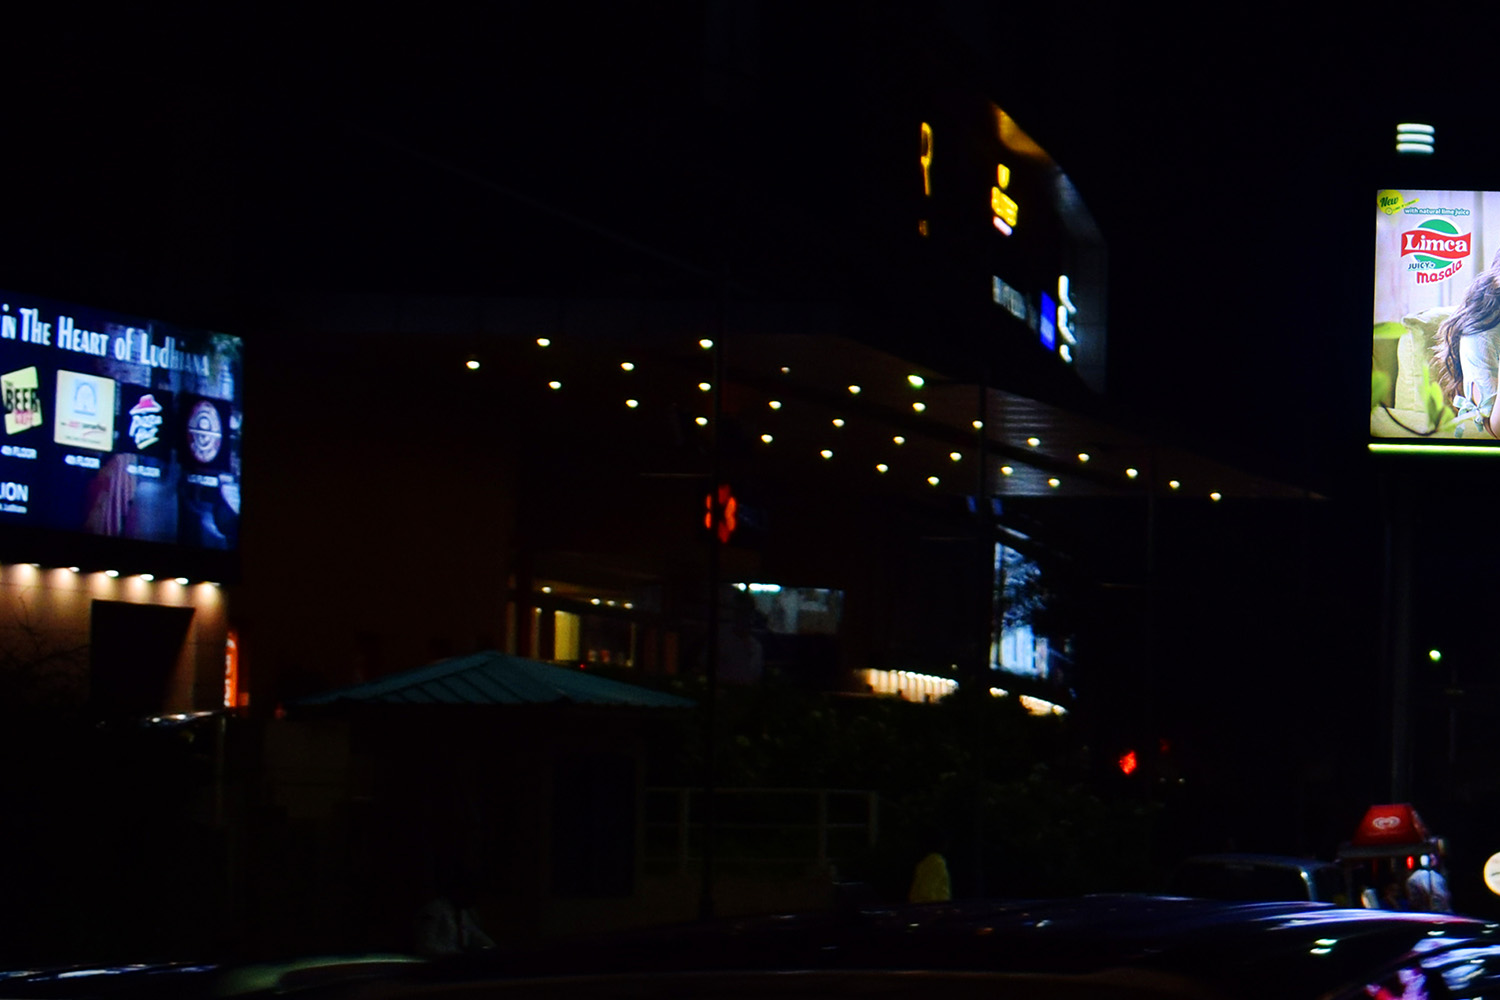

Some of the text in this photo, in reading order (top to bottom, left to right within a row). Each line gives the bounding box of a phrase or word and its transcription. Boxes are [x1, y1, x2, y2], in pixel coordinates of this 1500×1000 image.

[1380, 197, 1398, 207] New
[1455, 208, 1469, 216] juice
[1404, 234, 1468, 252] Limca
[1417, 260, 1462, 284] masala
